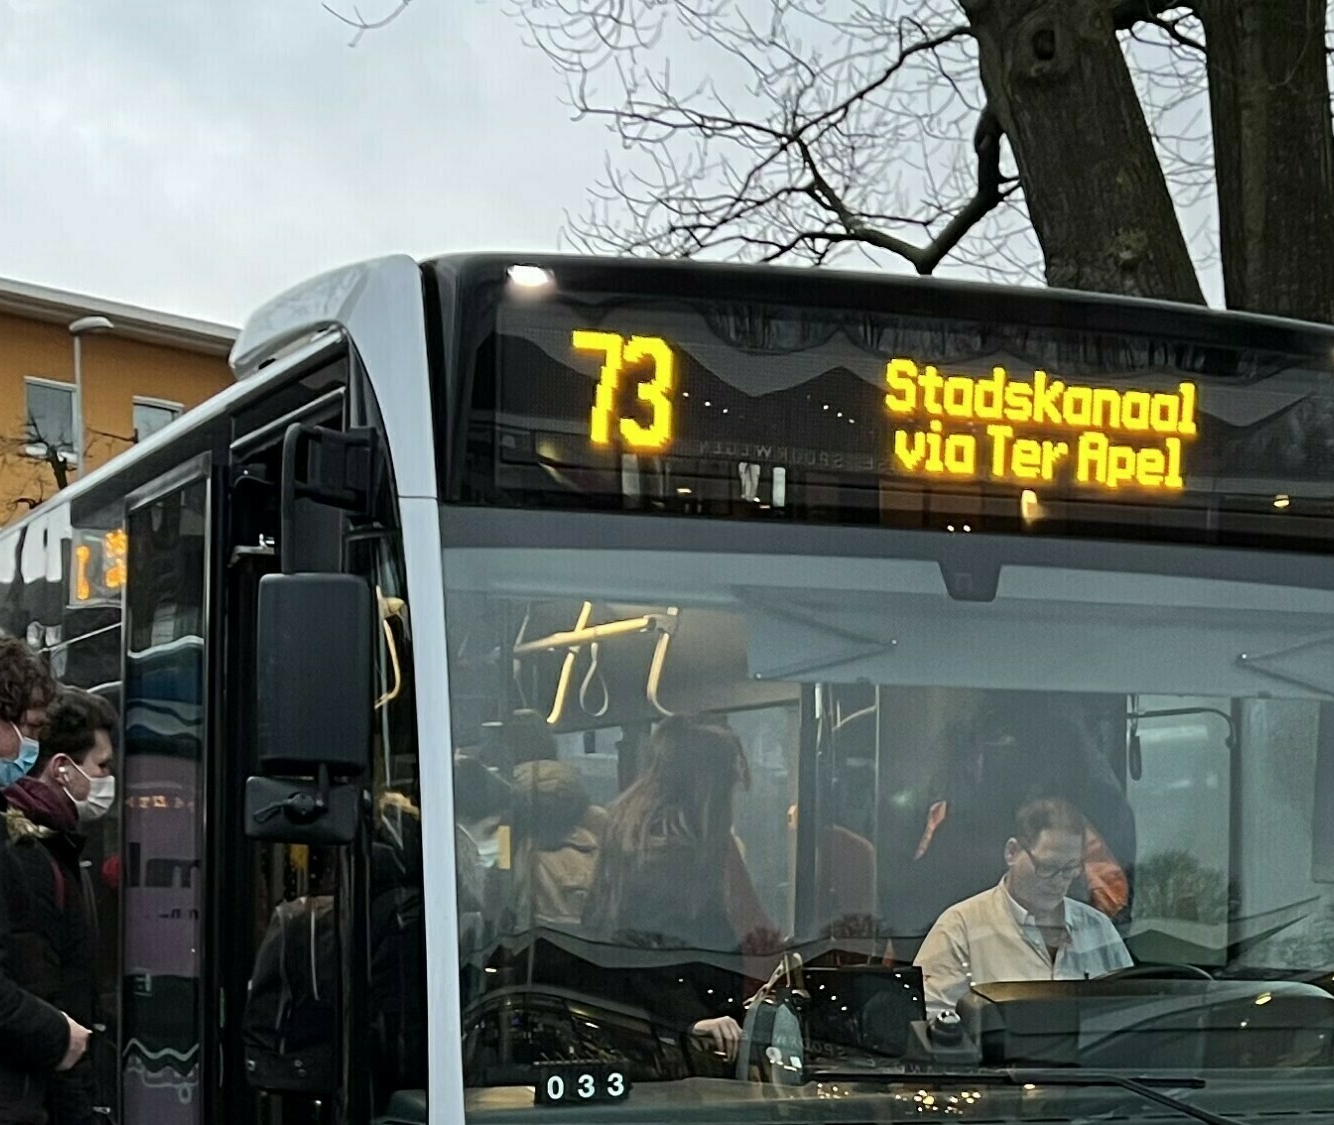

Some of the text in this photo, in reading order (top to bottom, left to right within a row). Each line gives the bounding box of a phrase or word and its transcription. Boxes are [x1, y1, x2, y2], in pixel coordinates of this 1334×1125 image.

[572, 330, 674, 447] 73
[885, 357, 1197, 435] Stadskanaal
[895, 420, 1184, 488] via Ter Apel
